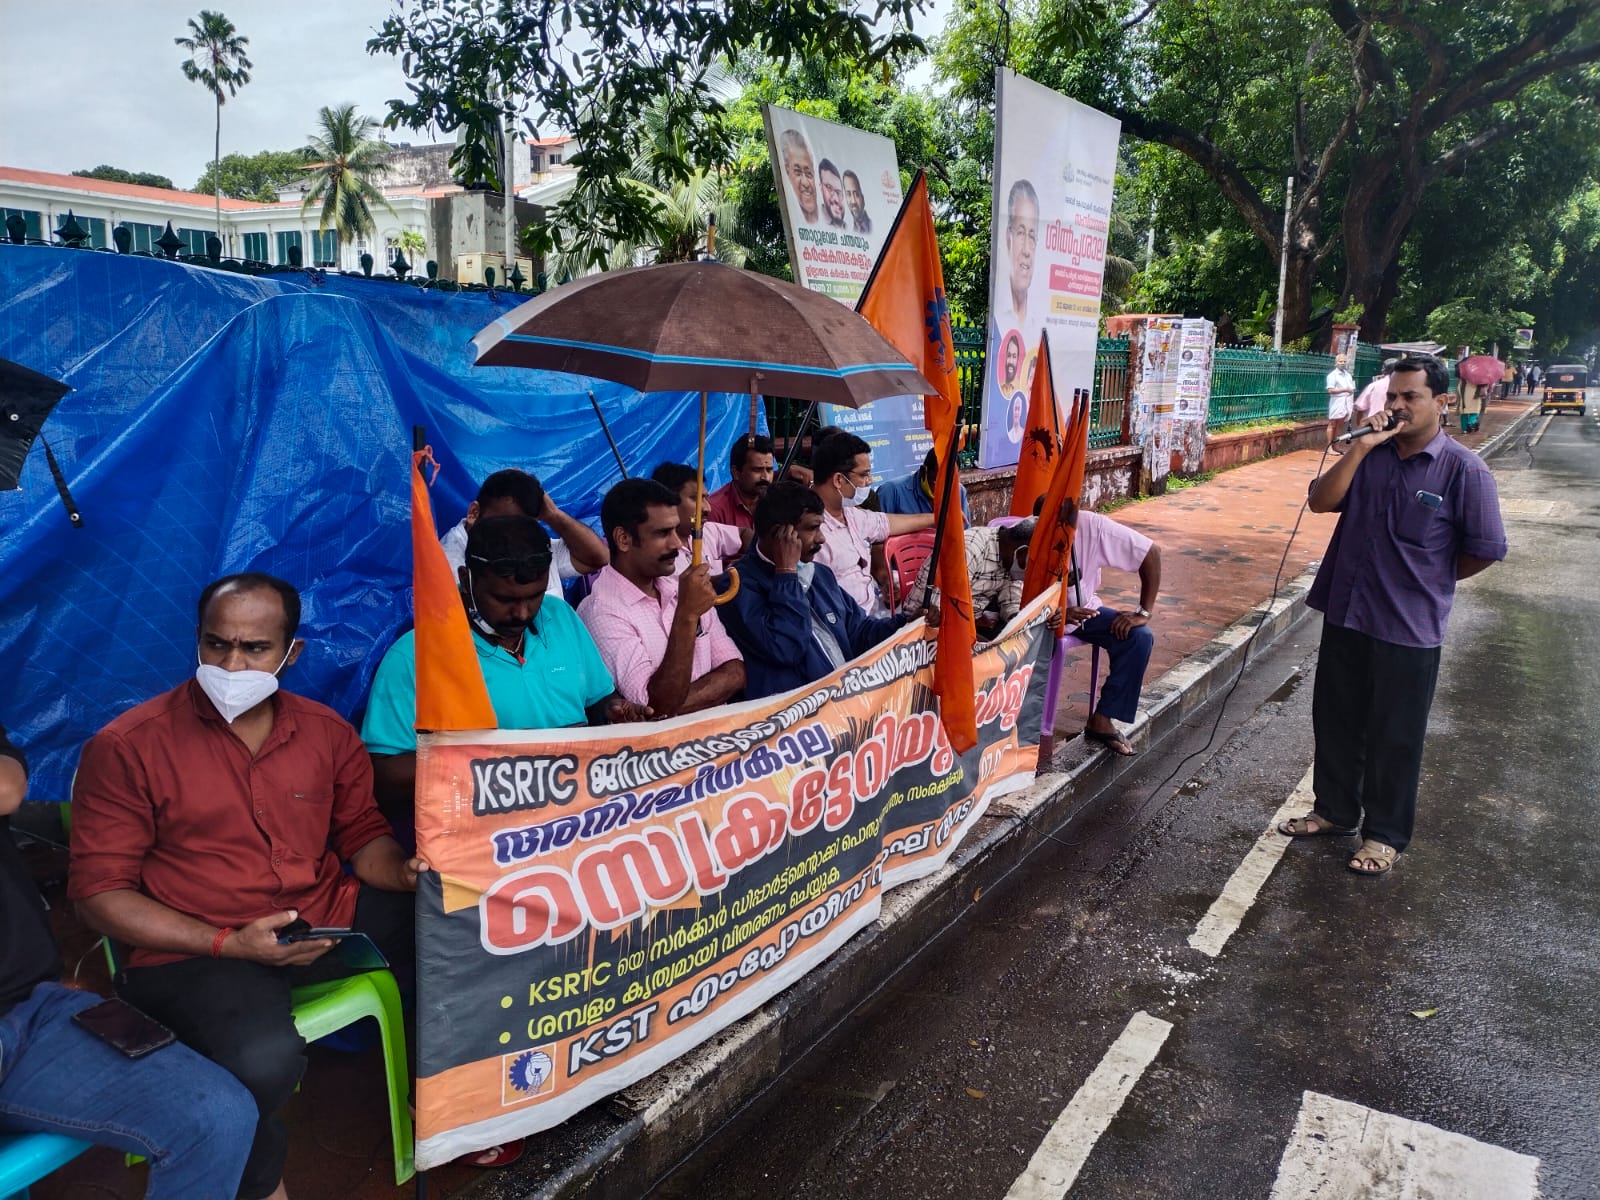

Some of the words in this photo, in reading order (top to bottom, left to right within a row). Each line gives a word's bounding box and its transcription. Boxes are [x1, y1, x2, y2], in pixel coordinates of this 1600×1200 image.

[474, 759, 574, 811] KSRTC
[590, 722, 776, 794] ജീവനക്കാരുടെ
[494, 724, 831, 864] അനിശ്ചിതകാല
[527, 995, 615, 1040] ശമ്പളം
[622, 938, 720, 1006] കൃത്യമായി
[722, 901, 787, 955] വിതരണം
[790, 866, 841, 909] ചെയ്യുക
[529, 963, 611, 1006] KSRTC
[618, 953, 645, 978] യെ
[650, 905, 728, 962] സർക്കാർ
[569, 1006, 657, 1075] KST
[670, 875, 868, 1024] എംപ്ലോയീസ്
